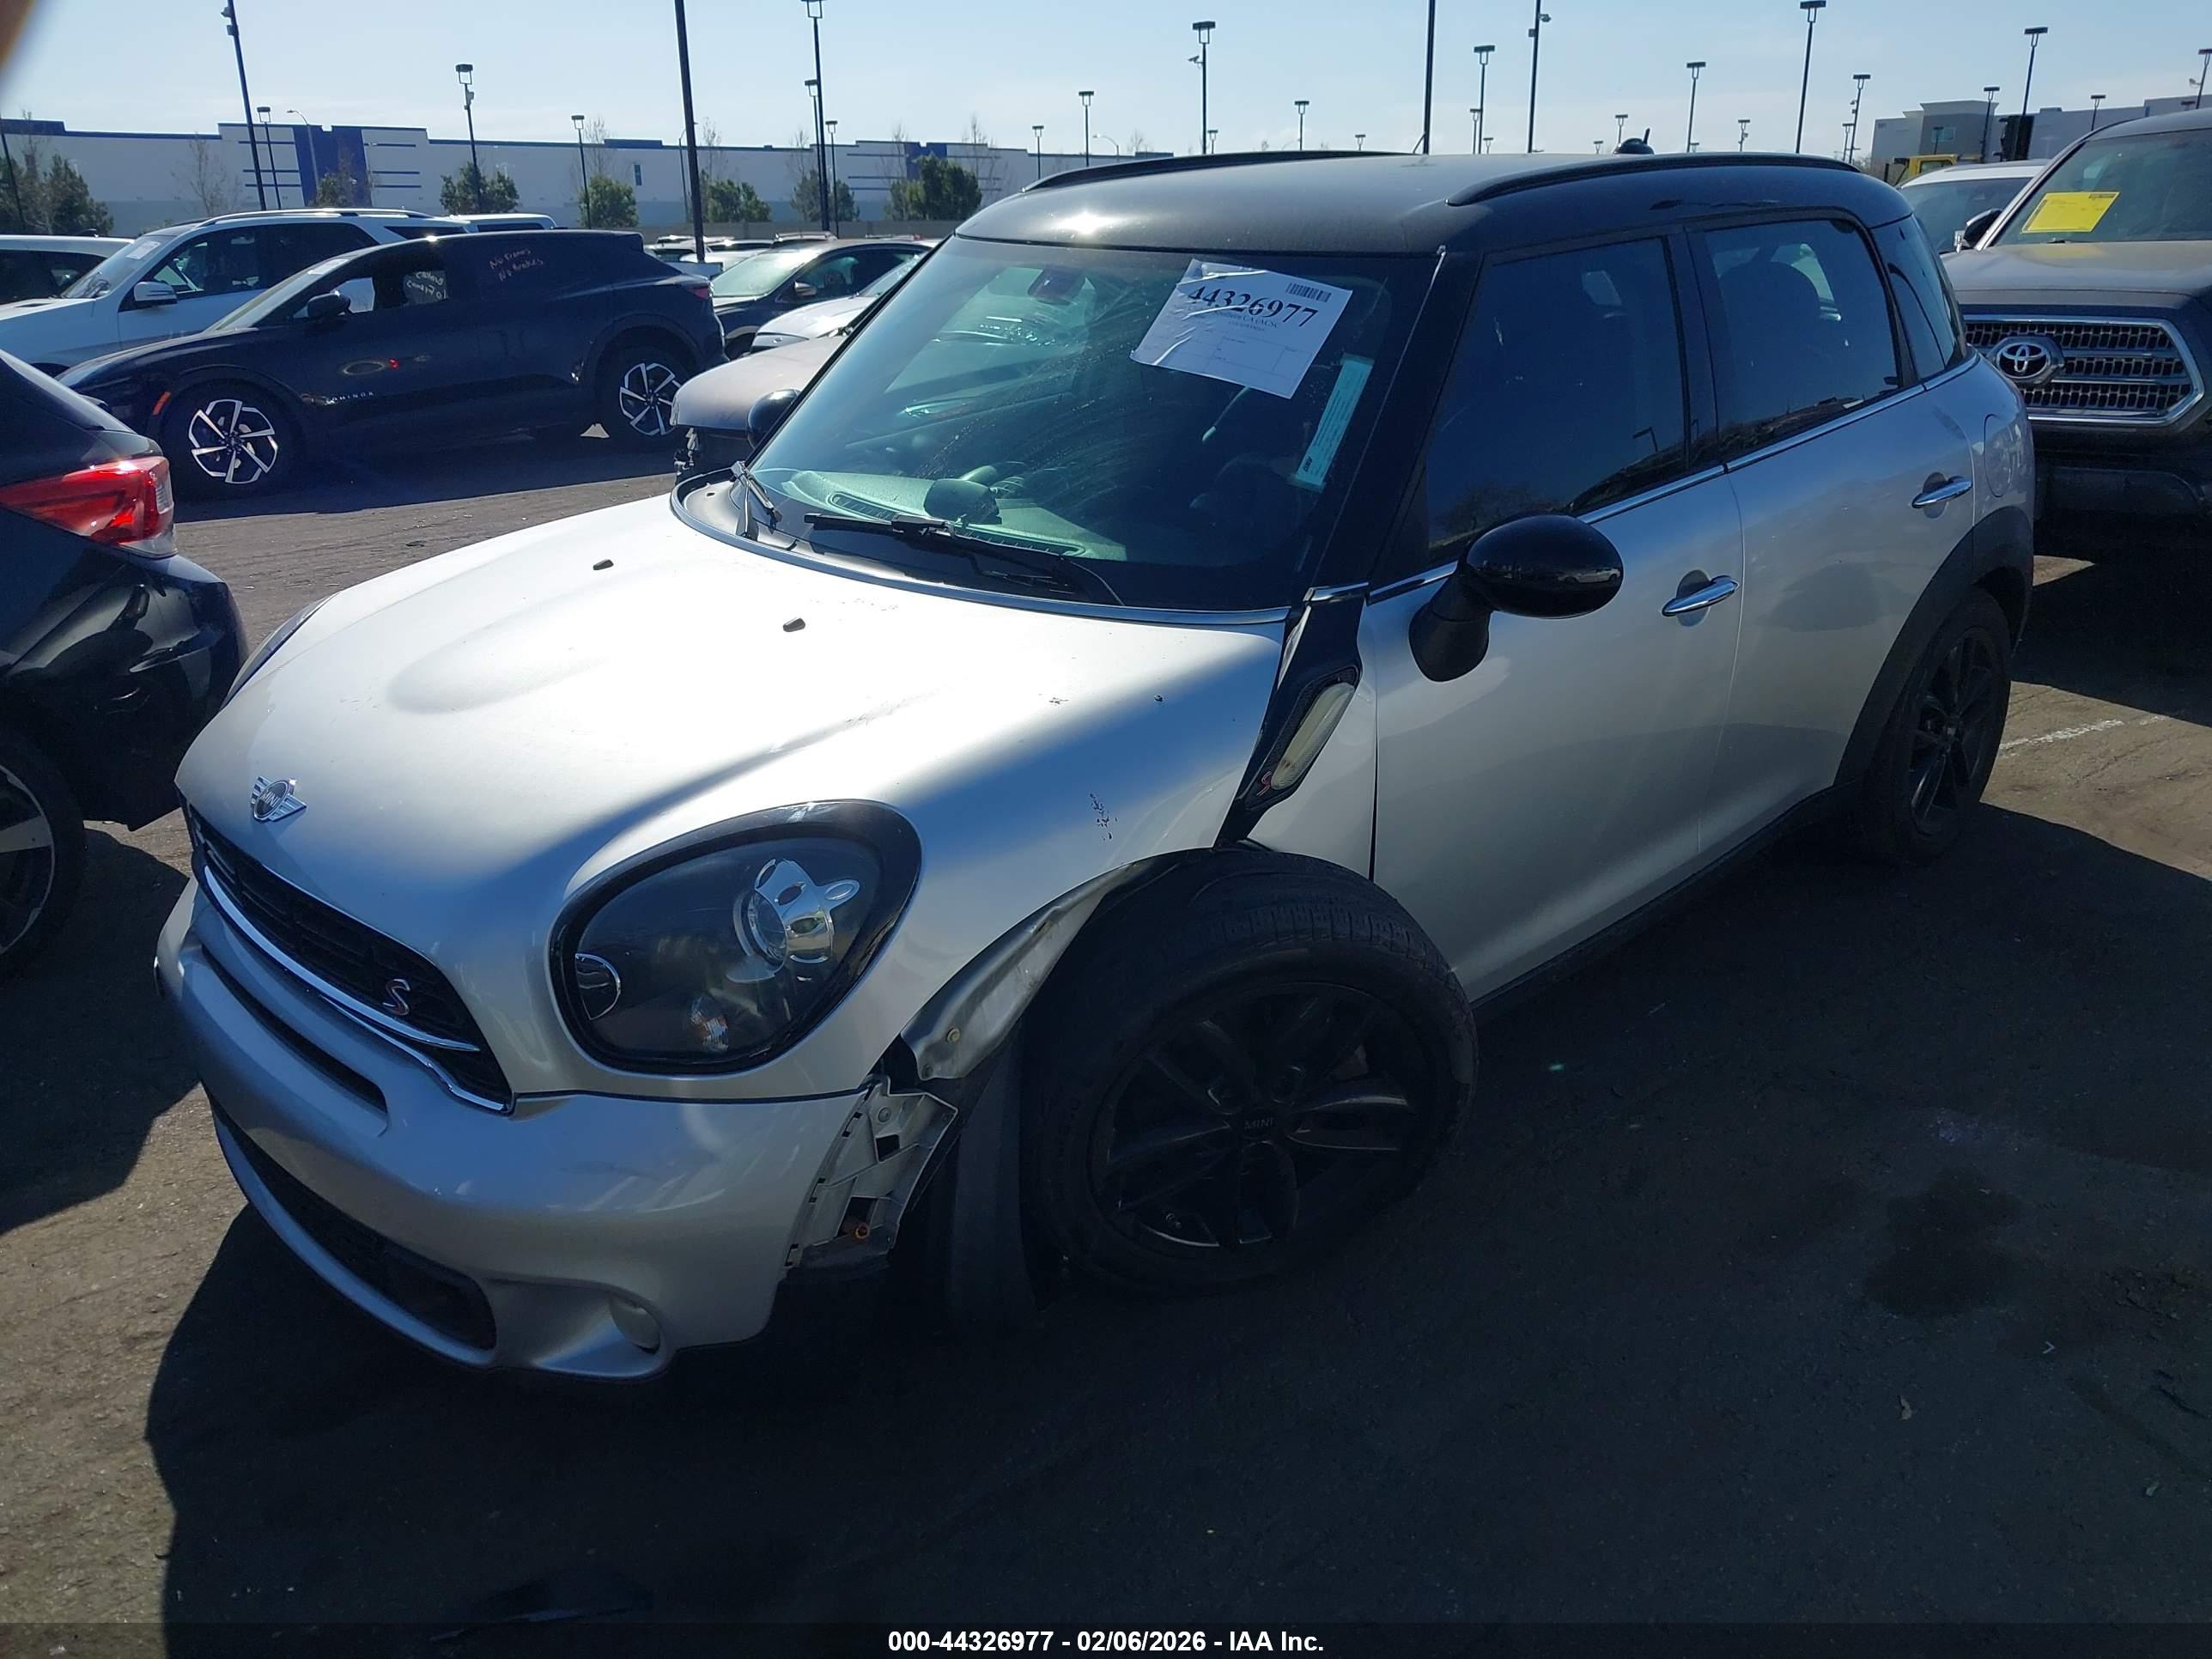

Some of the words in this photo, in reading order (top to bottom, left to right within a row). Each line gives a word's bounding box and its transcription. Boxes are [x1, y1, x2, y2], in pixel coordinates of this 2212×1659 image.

[1188, 286, 1319, 328] 44326977
[259, 789, 281, 807] MINI
[382, 978, 410, 1016] S
[1243, 1116, 1275, 1131] MINI
